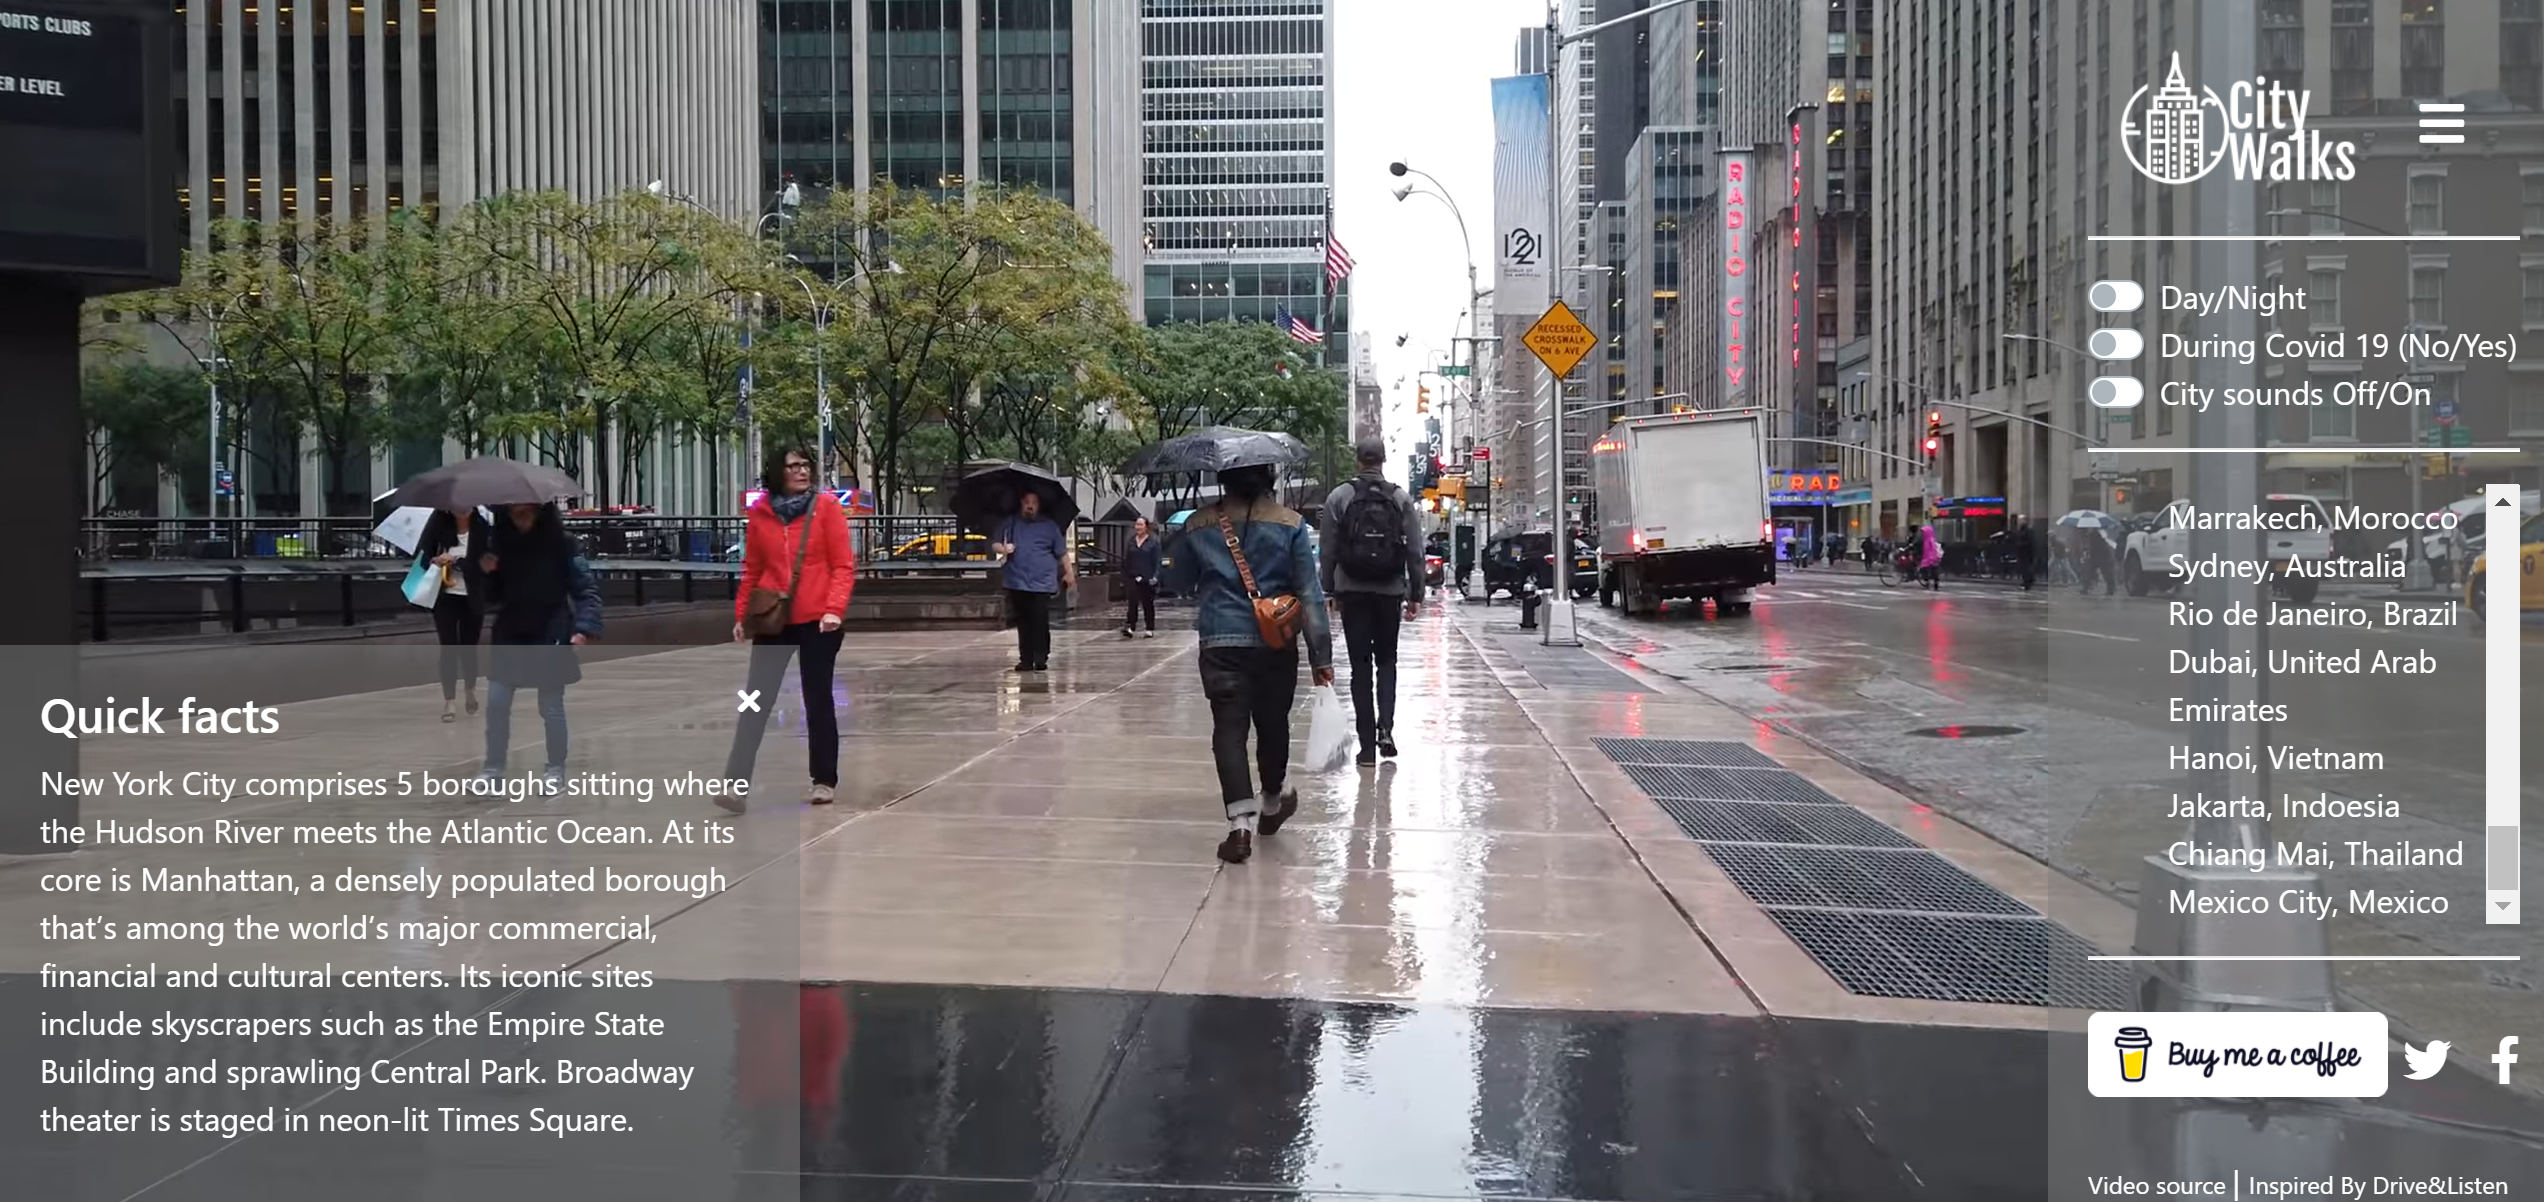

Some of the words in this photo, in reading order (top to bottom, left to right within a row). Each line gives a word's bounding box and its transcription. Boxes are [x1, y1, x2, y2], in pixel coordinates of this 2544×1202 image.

[44, 16, 92, 36] CLUBS
[20, 77, 65, 96] LEVEL
[1727, 162, 1746, 277] RADIO
[1537, 324, 1582, 334] RECESSED
[1533, 335, 1587, 345] CROSSWALK
[1726, 298, 1746, 386] CITY
[1540, 347, 1551, 356] ON
[1554, 347, 1561, 356] 6
[1564, 347, 1580, 356] AVE
